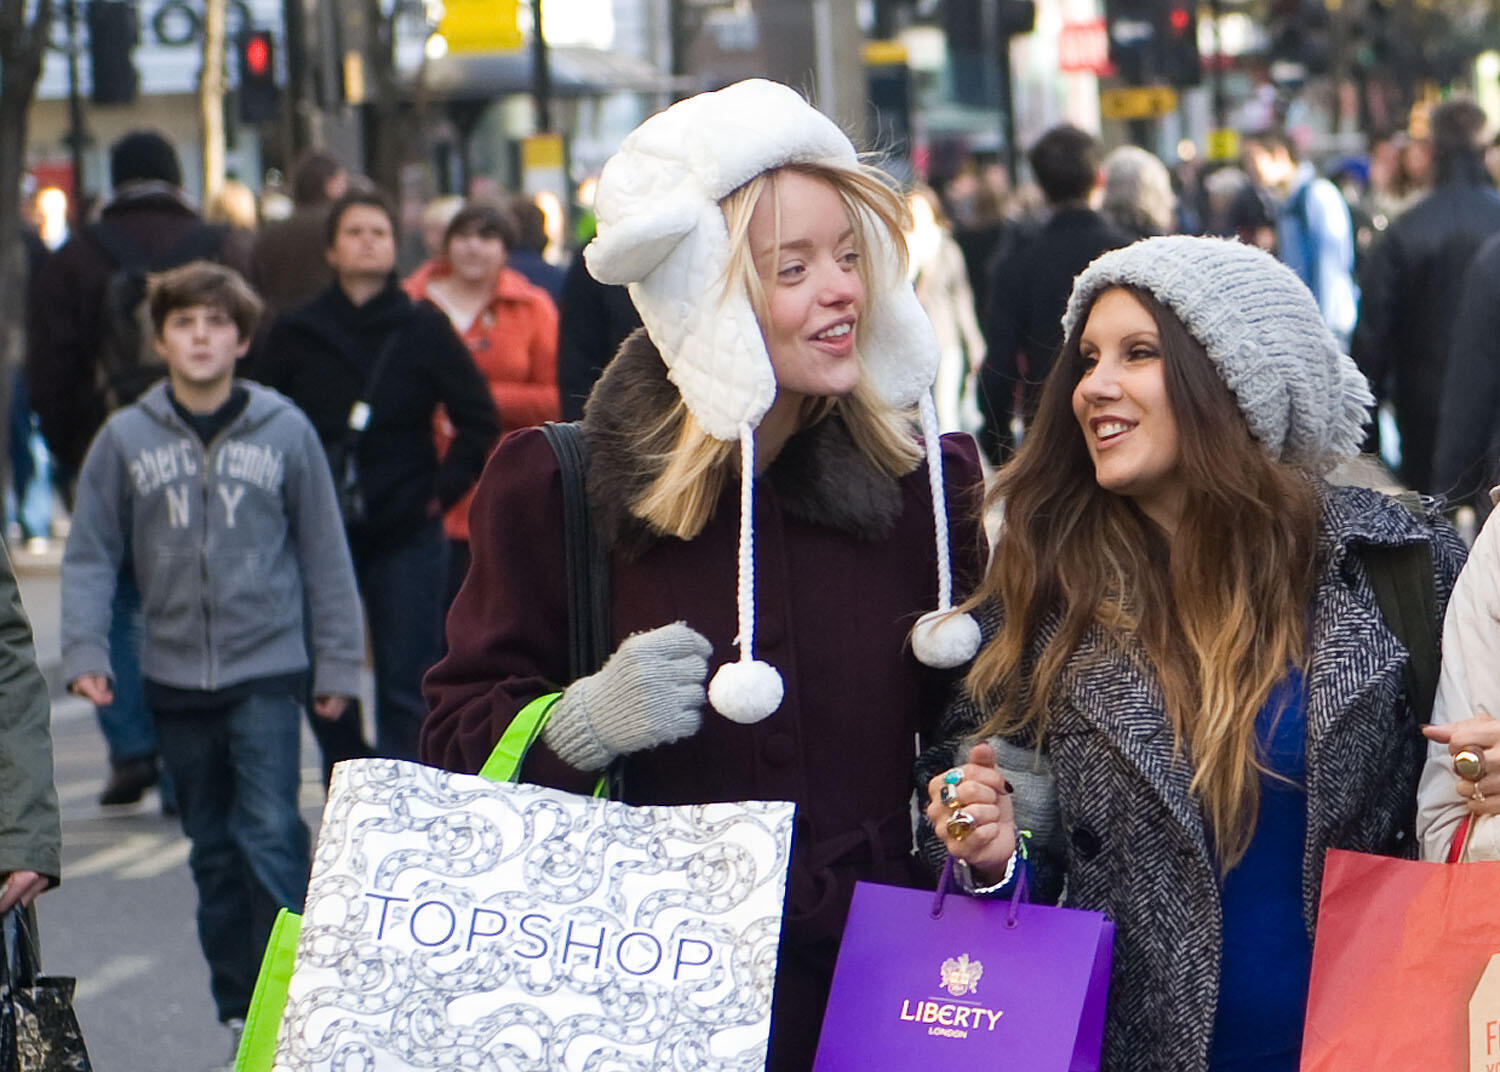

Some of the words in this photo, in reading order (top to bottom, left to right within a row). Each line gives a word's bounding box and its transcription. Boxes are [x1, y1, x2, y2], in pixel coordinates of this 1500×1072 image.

[166, 484, 190, 528] N
[217, 484, 245, 528] Y
[365, 892, 713, 980] TOPSHOP
[900, 999, 1004, 1031] LIBERTY
[928, 1027, 968, 1039] LONDON
